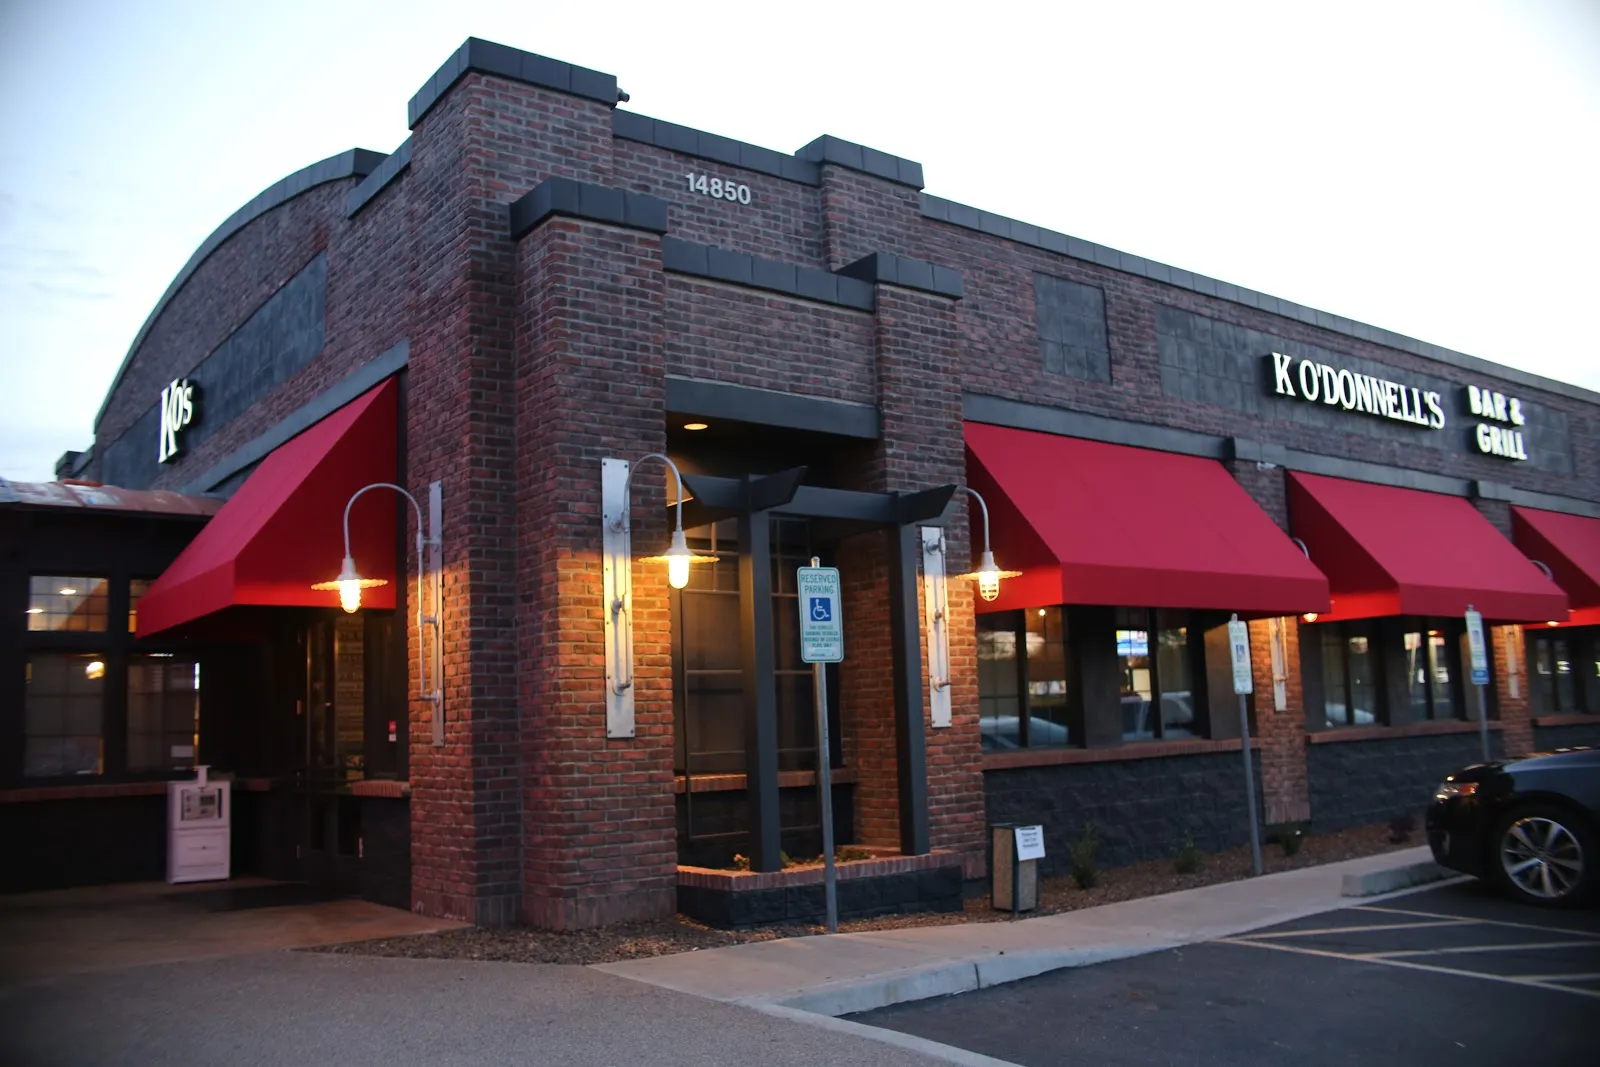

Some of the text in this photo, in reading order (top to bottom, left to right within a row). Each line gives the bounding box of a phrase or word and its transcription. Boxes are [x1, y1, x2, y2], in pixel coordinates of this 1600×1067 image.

[685, 172, 751, 205] 14850
[1272, 352, 1446, 430] K O'DONNELL'S
[1468, 384, 1525, 426] BAR &
[1476, 422, 1528, 461] GRILL
[800, 573, 837, 584] RESERVED
[804, 585, 834, 595] PARKING
